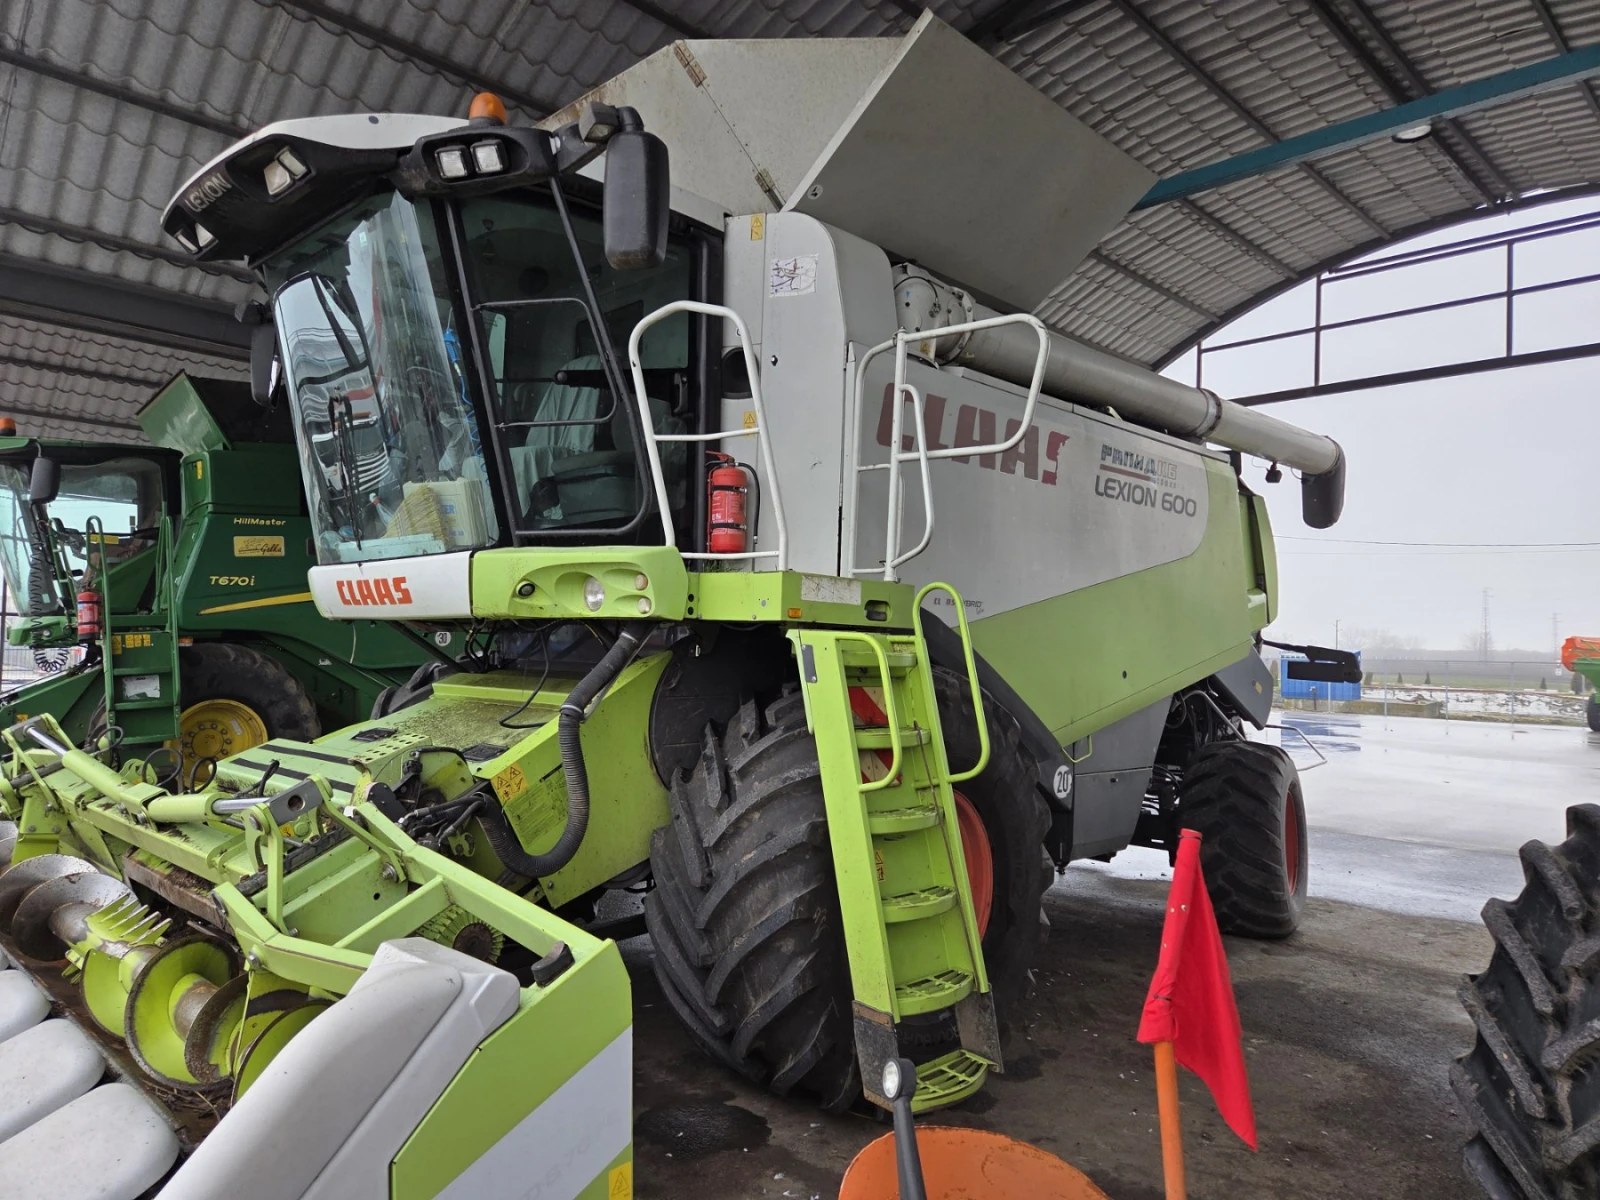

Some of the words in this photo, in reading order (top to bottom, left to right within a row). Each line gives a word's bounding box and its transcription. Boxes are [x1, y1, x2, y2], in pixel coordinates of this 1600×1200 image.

[184, 172, 232, 212] LEXION
[876, 382, 1070, 485] CLAAS
[1095, 474, 1157, 508] LEXION
[1161, 491, 1197, 517] 600
[233, 517, 286, 526] HillMaster
[209, 575, 255, 586] T670i
[336, 576, 413, 606] CLAAS
[438, 632, 448, 644] 30
[1057, 771, 1069, 793] 20
